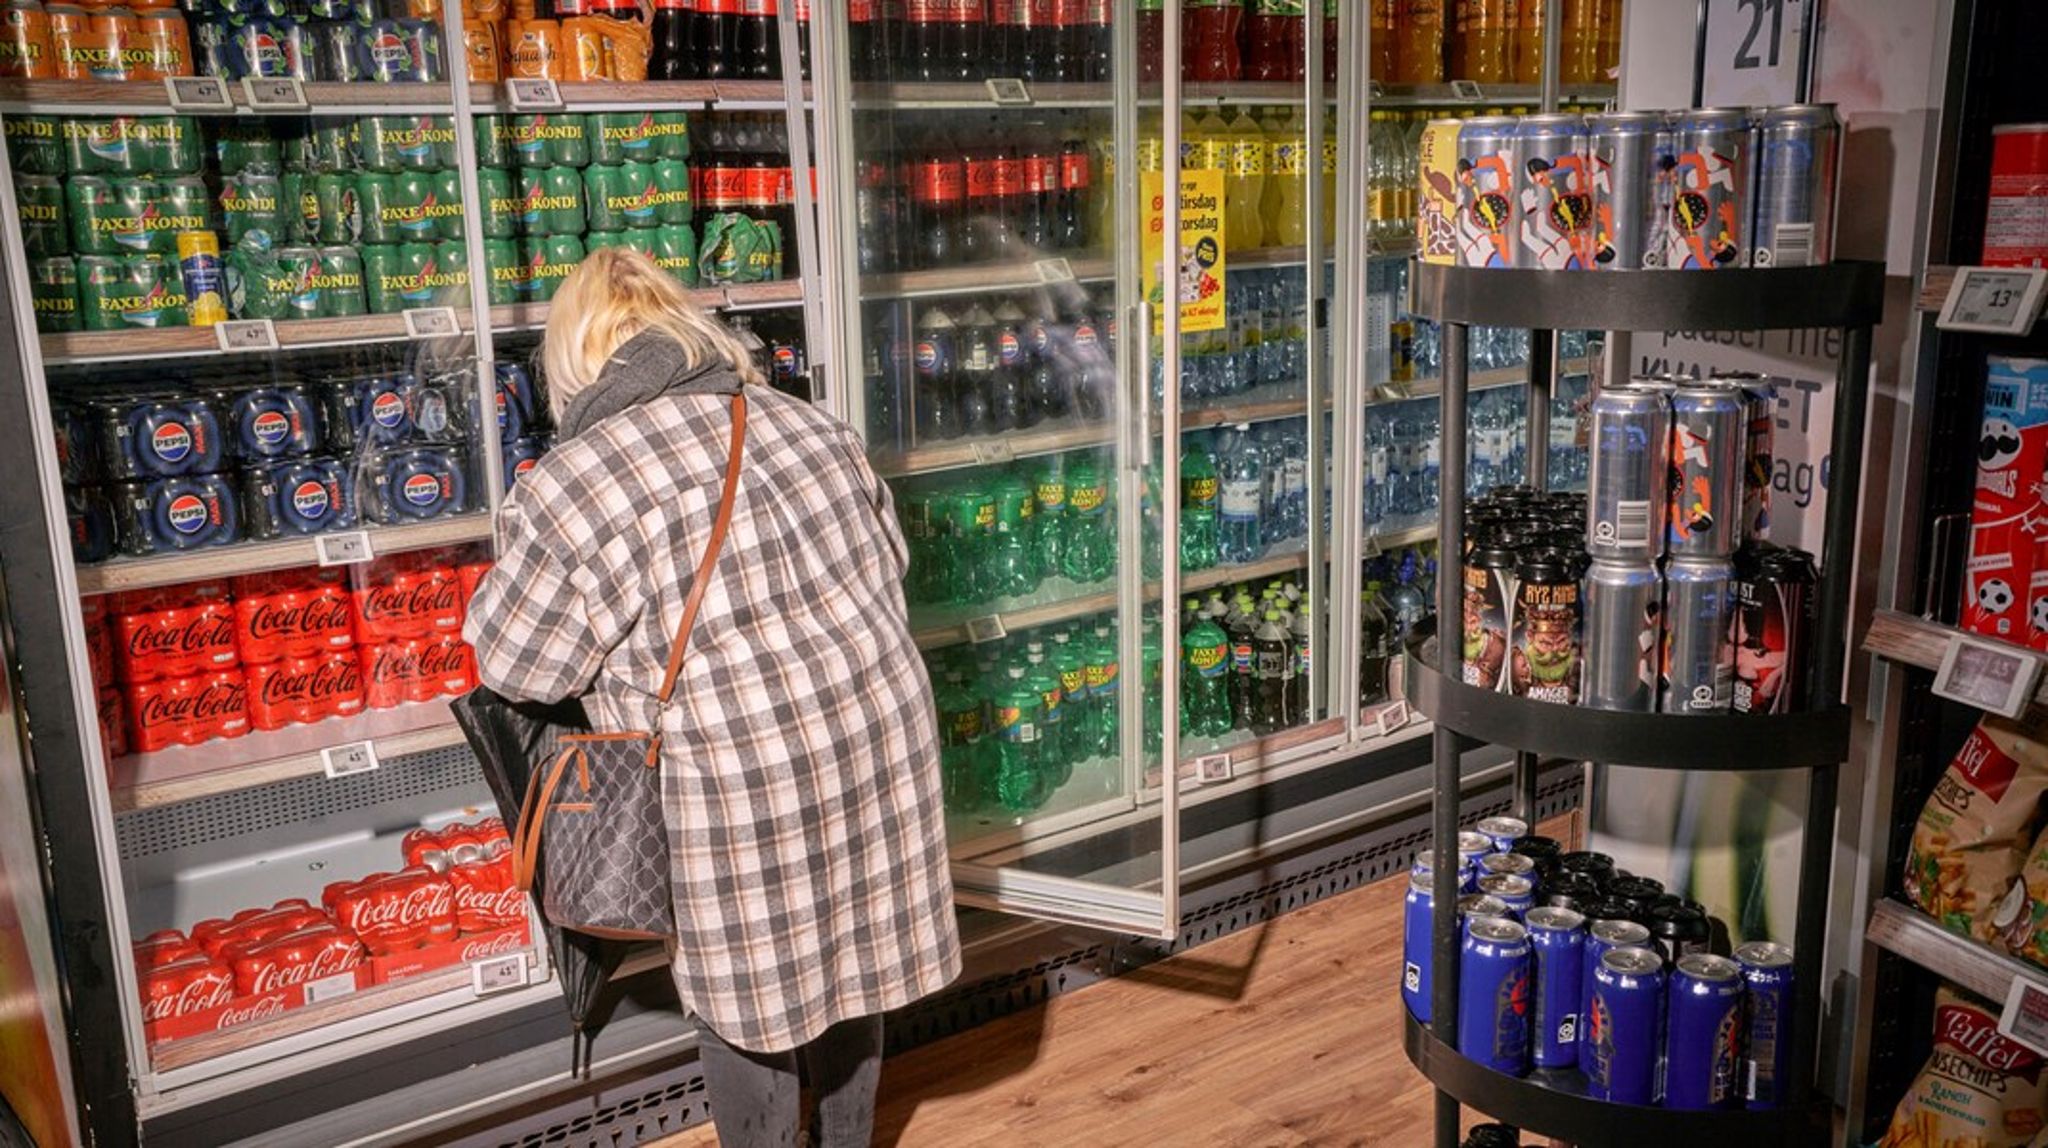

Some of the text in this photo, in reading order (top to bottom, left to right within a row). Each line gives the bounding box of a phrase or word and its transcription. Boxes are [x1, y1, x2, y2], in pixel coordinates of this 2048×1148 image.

[63, 124, 184, 140] FAXE KONDI
[535, 125, 582, 140] KONDI
[223, 198, 276, 211] KONDI
[531, 195, 577, 210] KONDI
[382, 205, 419, 220] FAXE
[91, 215, 205, 231] FAXE KONDI
[1180, 213, 1219, 232] orsdag
[309, 272, 359, 288] KONDI
[381, 274, 419, 290] FAXE
[100, 297, 146, 311] FAXE
[255, 421, 288, 433] PEPSI
[155, 435, 189, 448] PEPSI
[407, 485, 438, 496] PEPSI
[295, 494, 328, 506] PEPSI
[171, 508, 205, 520] PEPSI
[1943, 1008, 2021, 1071] Taffel
